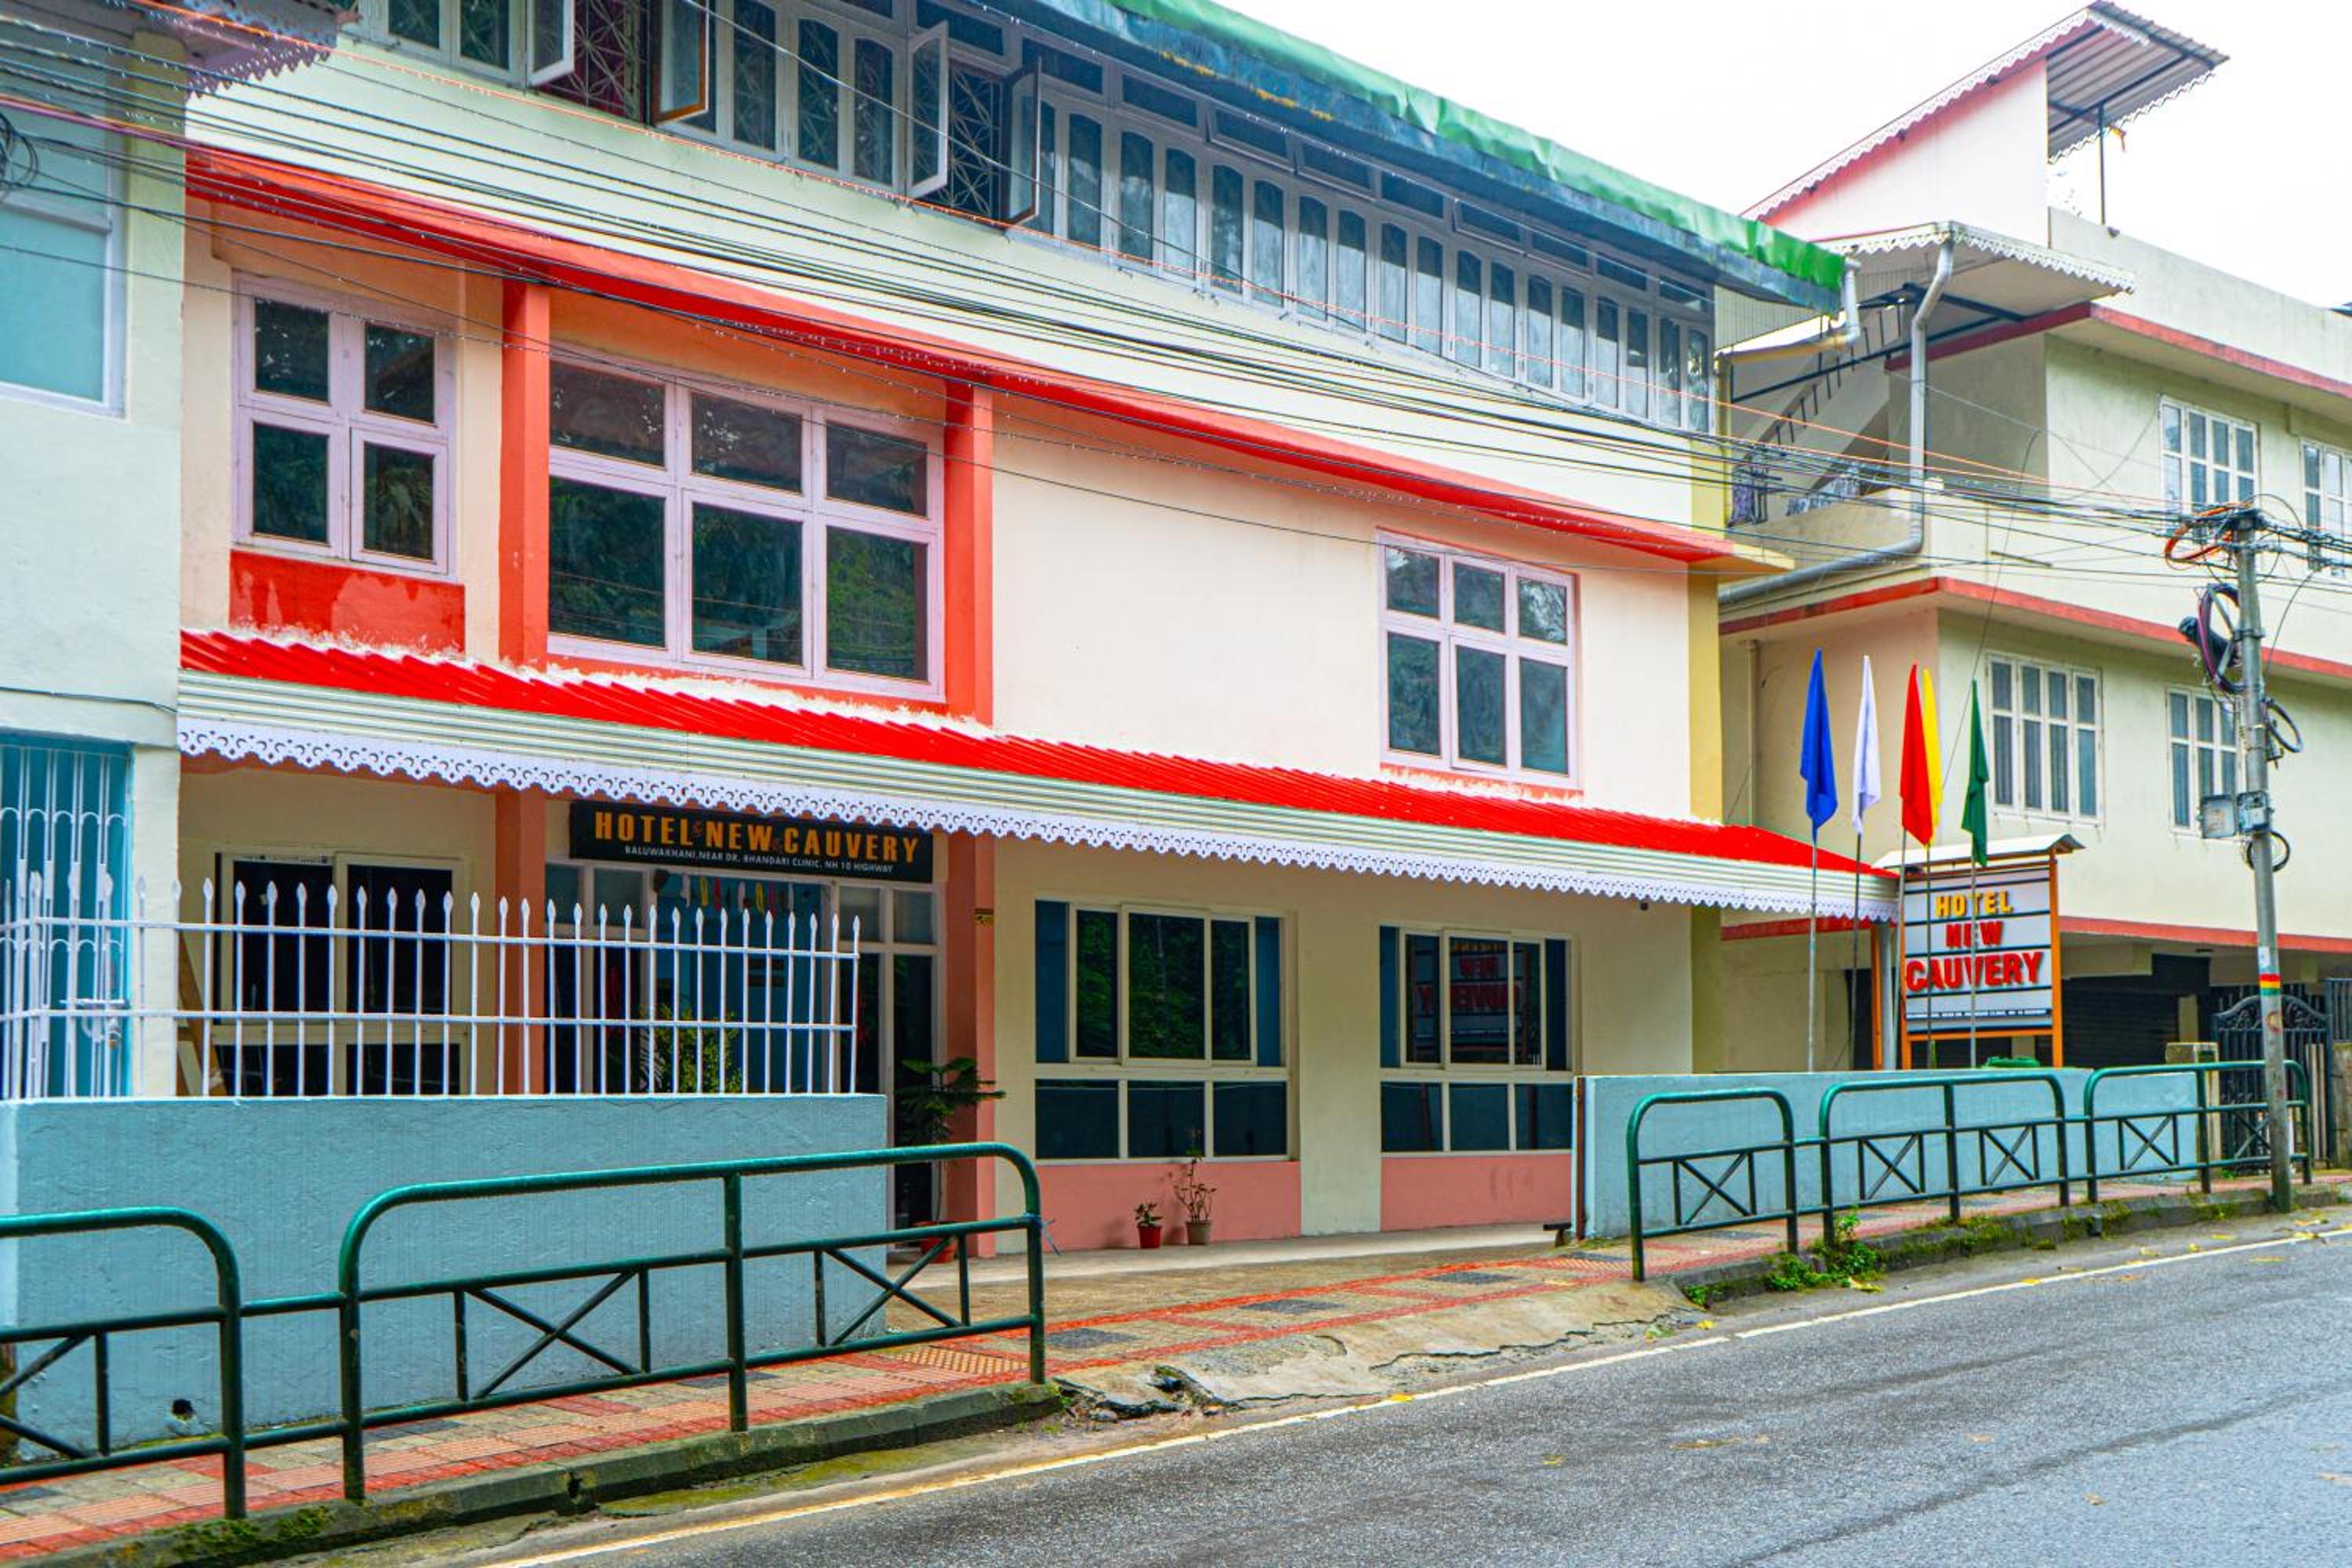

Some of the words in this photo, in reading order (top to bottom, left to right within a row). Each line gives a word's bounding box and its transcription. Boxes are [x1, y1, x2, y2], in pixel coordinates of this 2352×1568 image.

[595, 811, 693, 846] HOTEL
[706, 821, 772, 853] NEW
[784, 827, 919, 863] CAUVERY
[742, 852, 789, 866] BHANDARI
[825, 860, 838, 869] NH
[853, 862, 893, 873] HIGHWAY
[1935, 891, 2013, 917] HOTEL
[1905, 951, 2044, 993] CAUVERY
